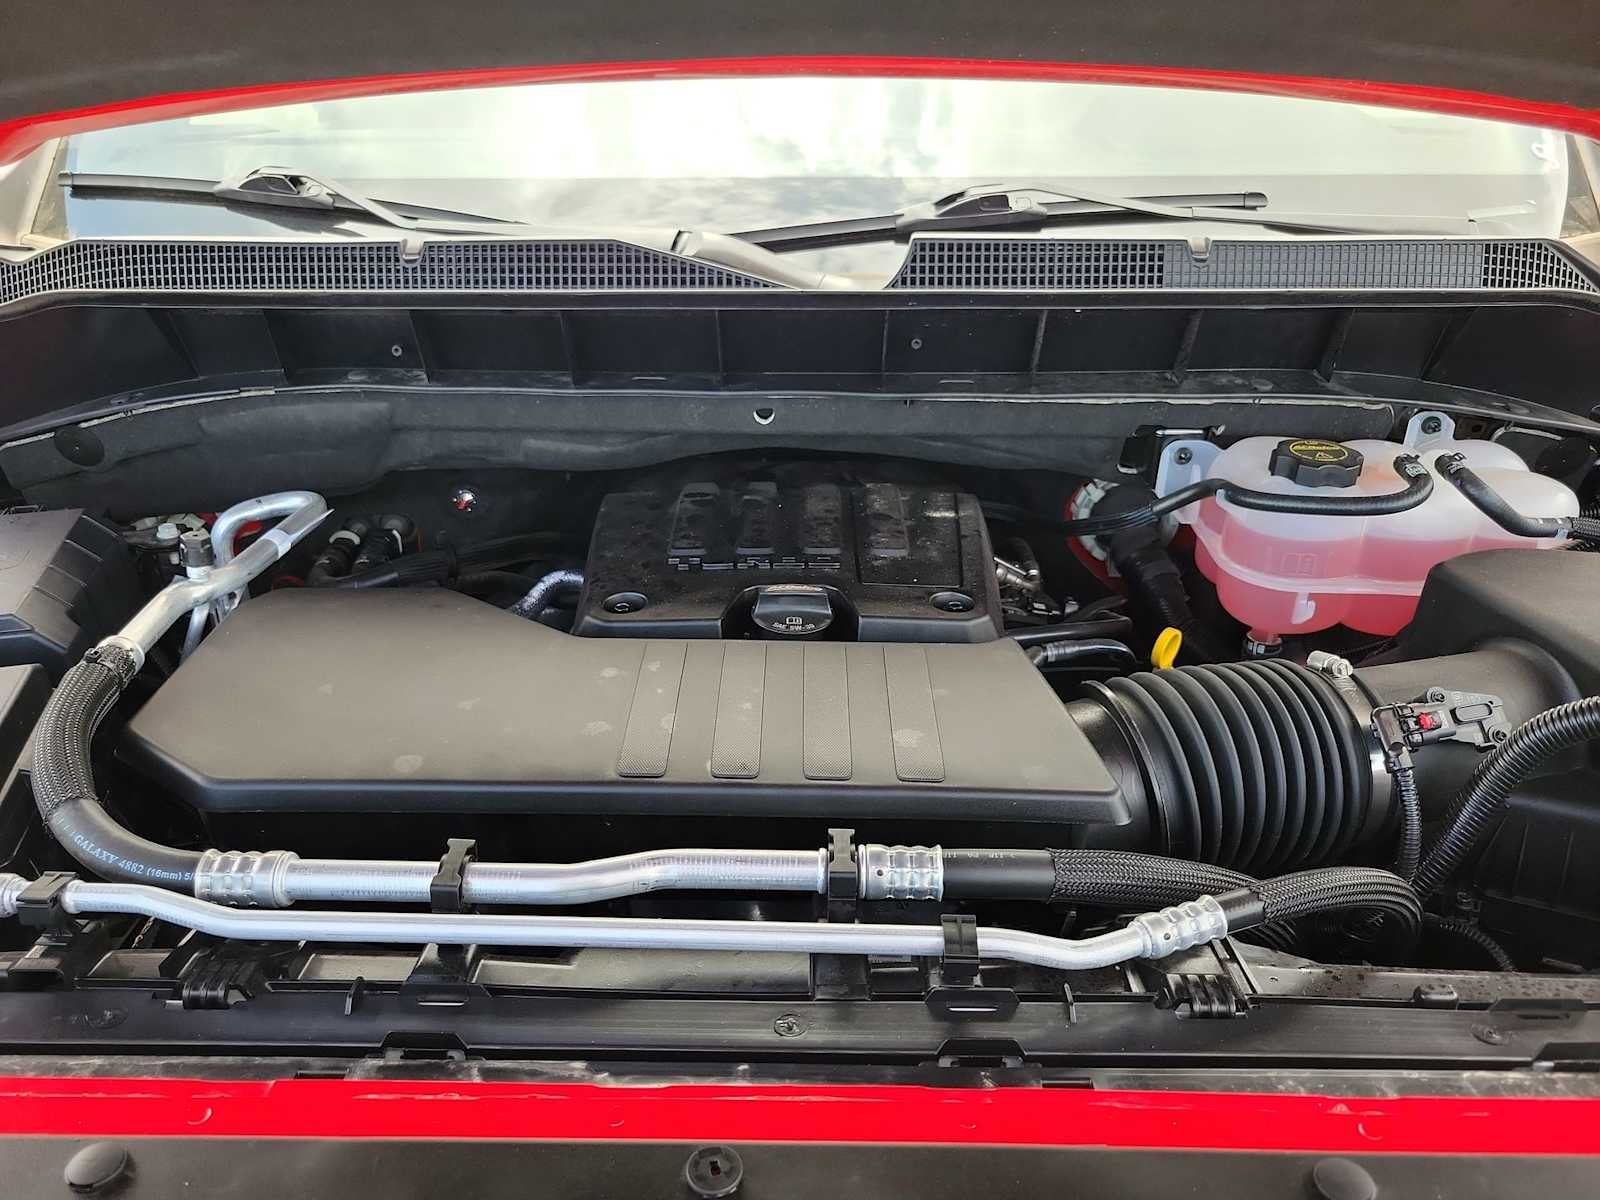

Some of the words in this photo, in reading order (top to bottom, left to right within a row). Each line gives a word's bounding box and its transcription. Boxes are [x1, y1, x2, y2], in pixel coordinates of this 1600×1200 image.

[74, 833, 119, 864] GALAXY
[119, 859, 144, 874] 4882
[147, 867, 182, 881] (16mm)
